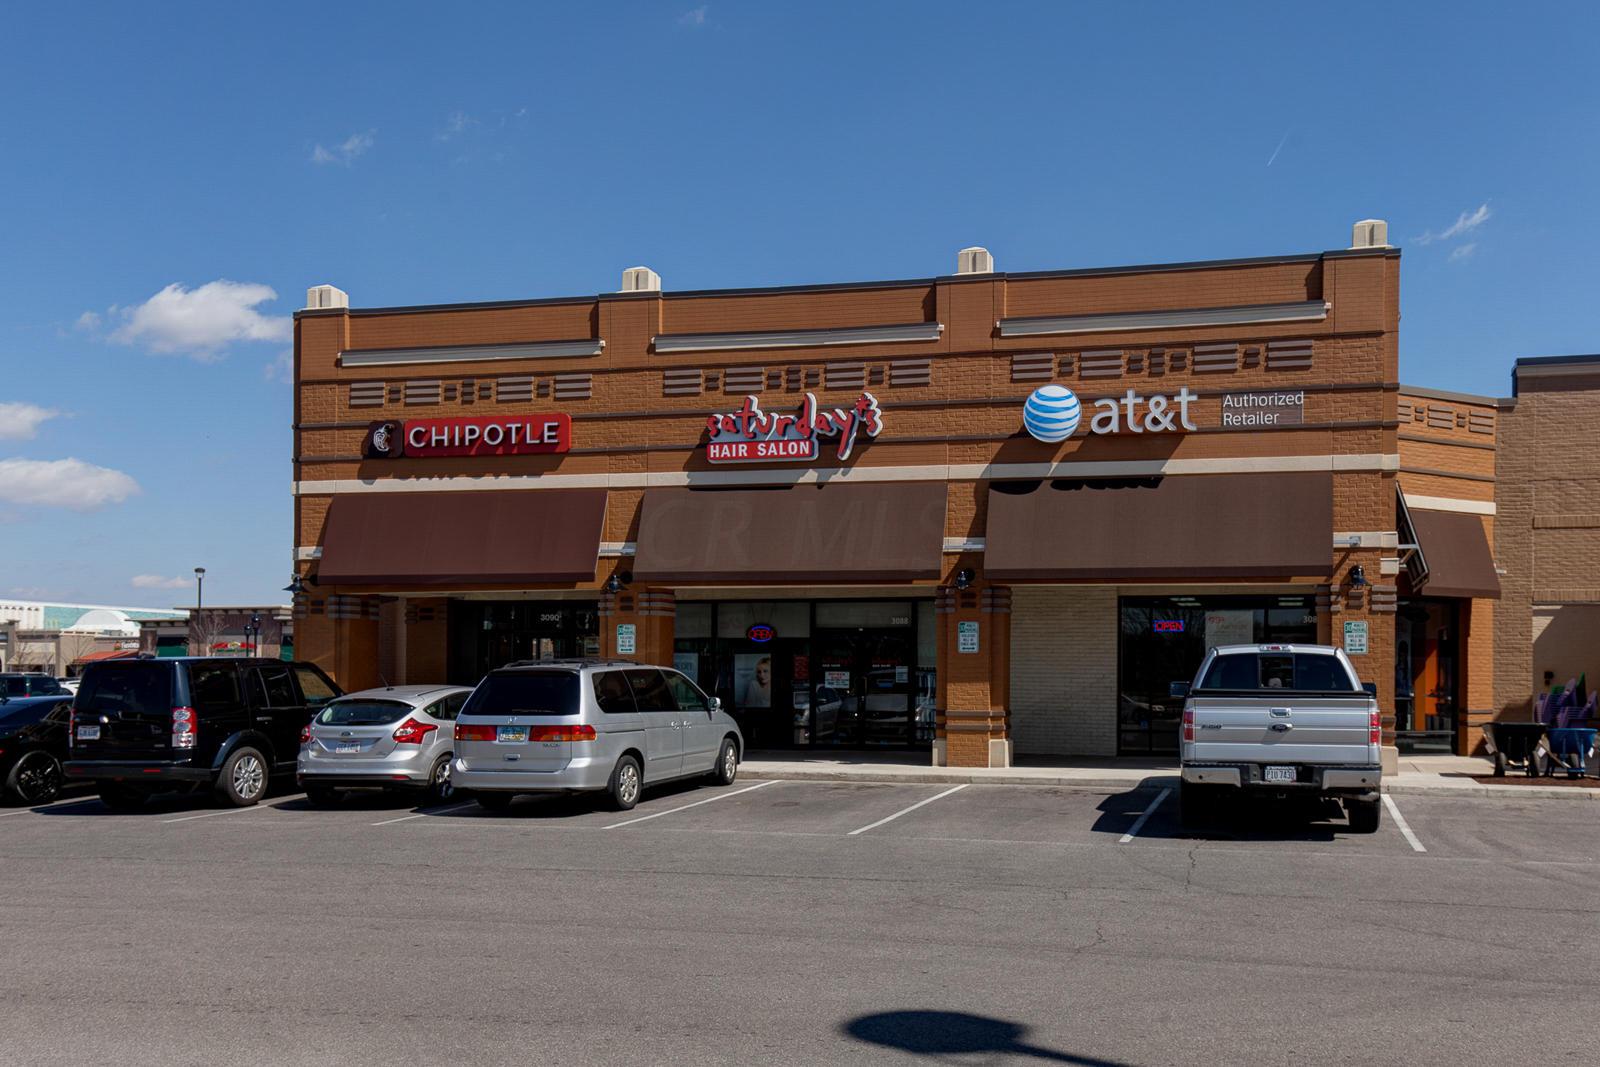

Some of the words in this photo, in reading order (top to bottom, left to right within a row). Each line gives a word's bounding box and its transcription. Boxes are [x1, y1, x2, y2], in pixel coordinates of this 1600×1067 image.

[1223, 391, 1304, 408] Authorized
[1090, 387, 1198, 434] at&t
[1223, 411, 1280, 426] Retailer
[409, 422, 560, 448] CHIPOTLE
[709, 444, 748, 458] HAIR
[757, 441, 810, 456] SALON
[747, 628, 773, 639] OPEN
[1155, 621, 1184, 631] OPEN
